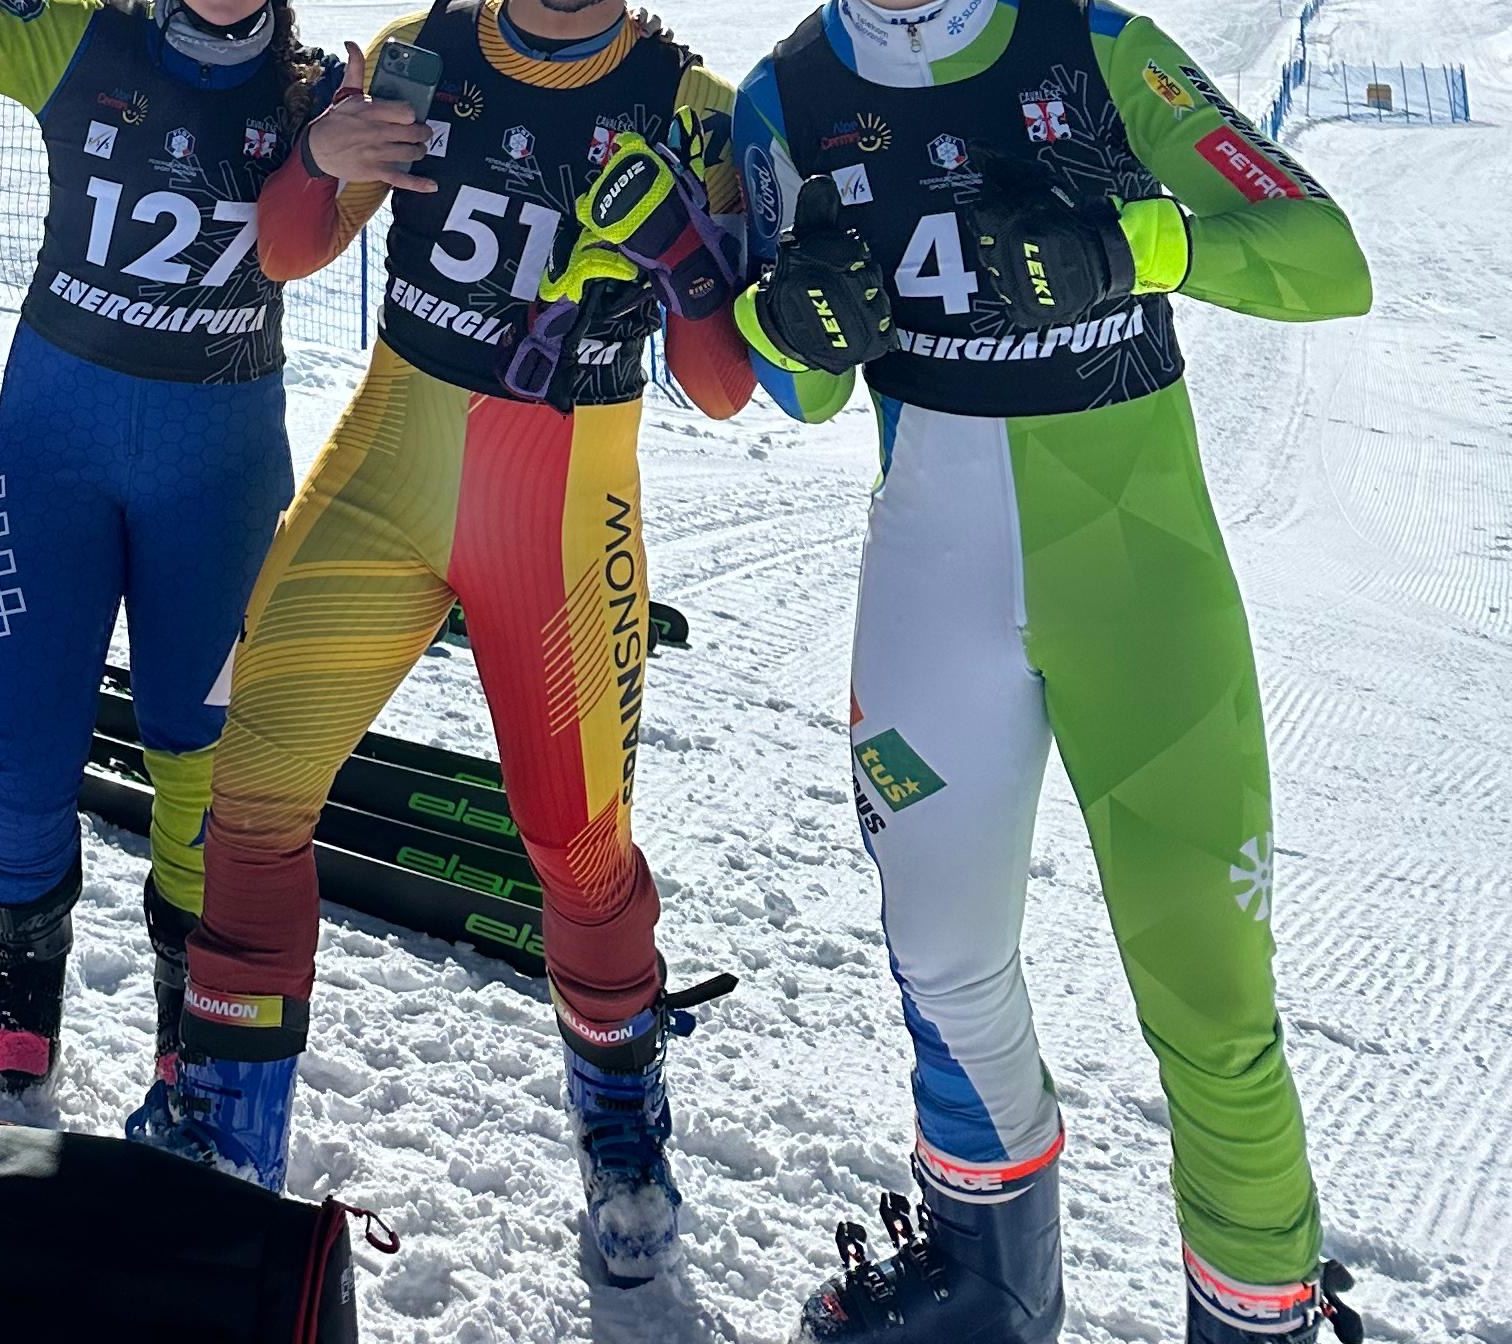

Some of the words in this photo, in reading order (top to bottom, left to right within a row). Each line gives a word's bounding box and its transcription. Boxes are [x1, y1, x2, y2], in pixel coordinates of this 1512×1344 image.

[1147, 60, 1181, 96] WIND
[752, 163, 777, 223] Ford
[86, 176, 259, 287] 127
[430, 184, 562, 302] 51
[894, 212, 979, 316] 4
[1023, 241, 1057, 306] LEKI
[49, 271, 267, 335] ENERGIAPURA
[807, 289, 849, 348] LEKI
[896, 304, 1144, 362] NERGIAPURA
[183, 989, 259, 1020] ALOMON
